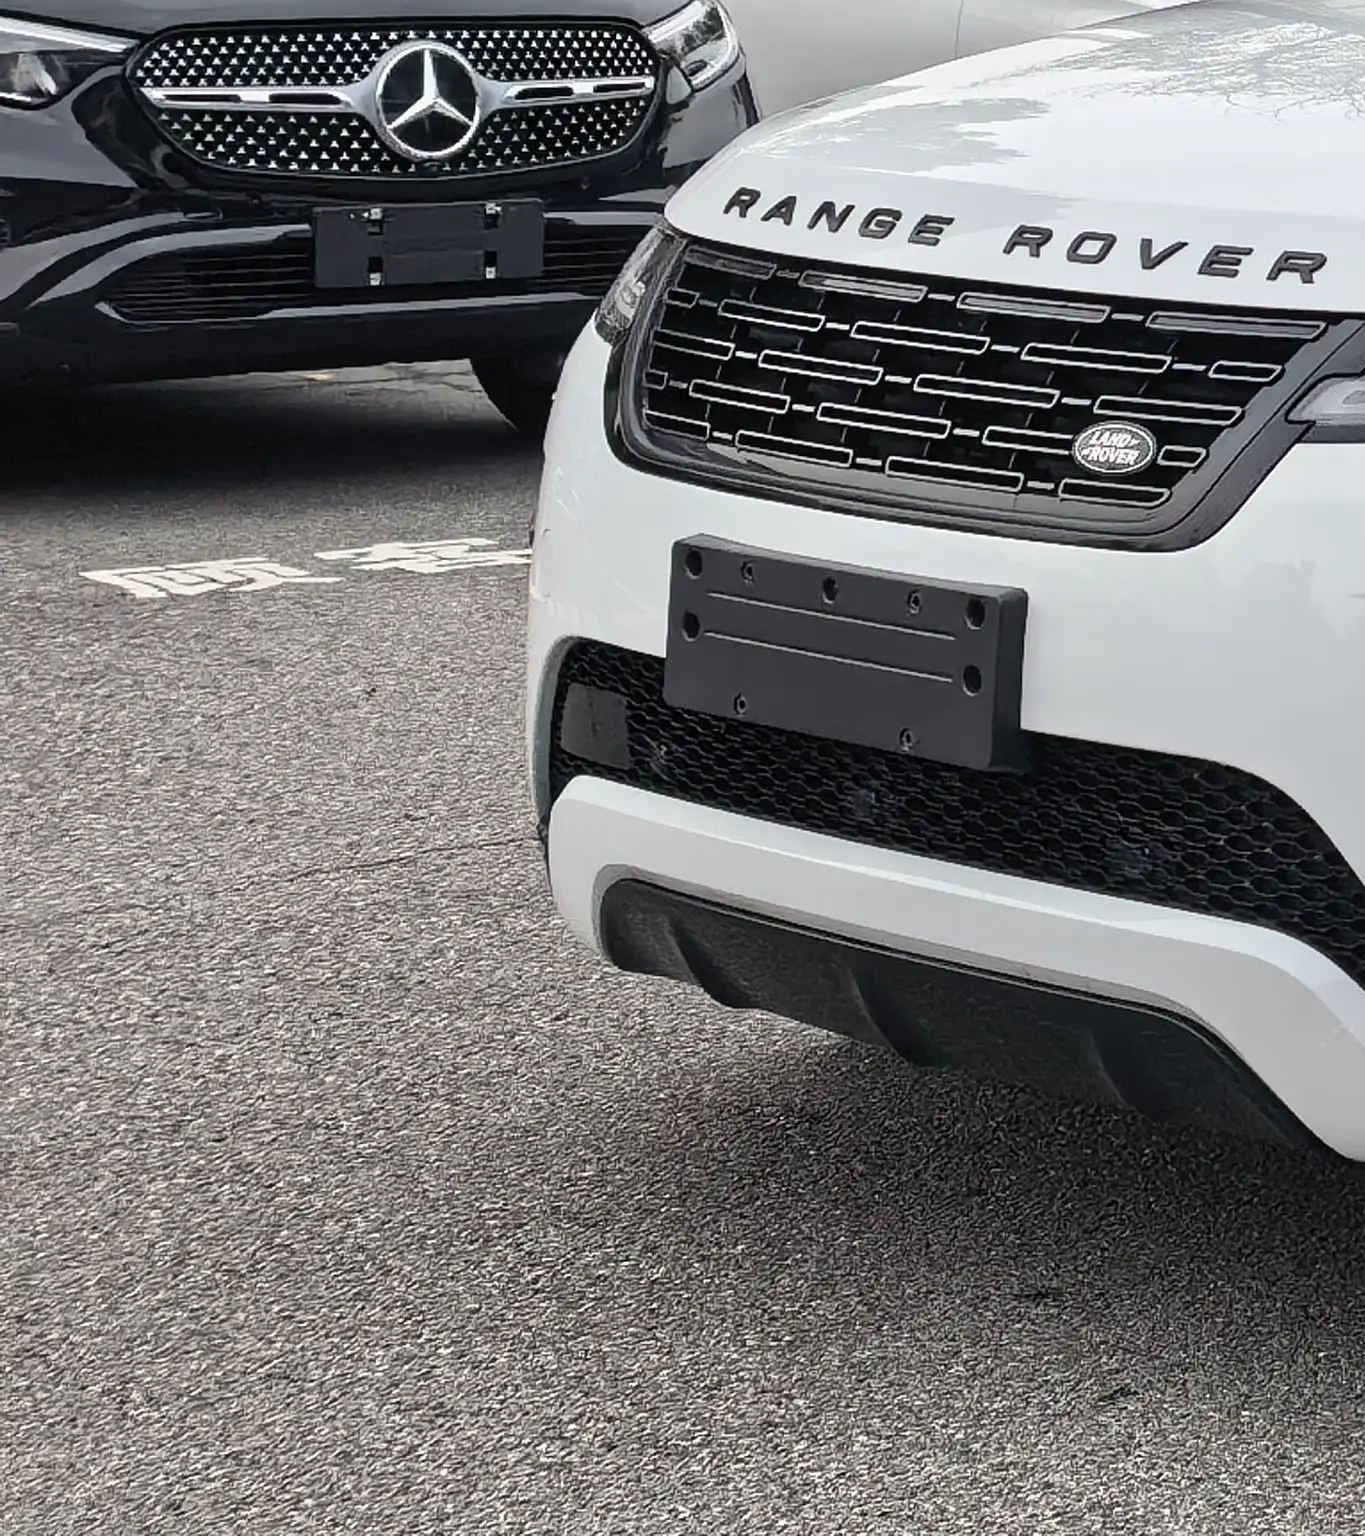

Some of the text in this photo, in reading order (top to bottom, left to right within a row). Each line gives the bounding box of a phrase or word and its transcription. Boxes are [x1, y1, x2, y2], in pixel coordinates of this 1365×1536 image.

[723, 186, 1328, 284] RANGE ROVER
[1089, 430, 1133, 448] LAND
[1088, 447, 1140, 465] ROVER
